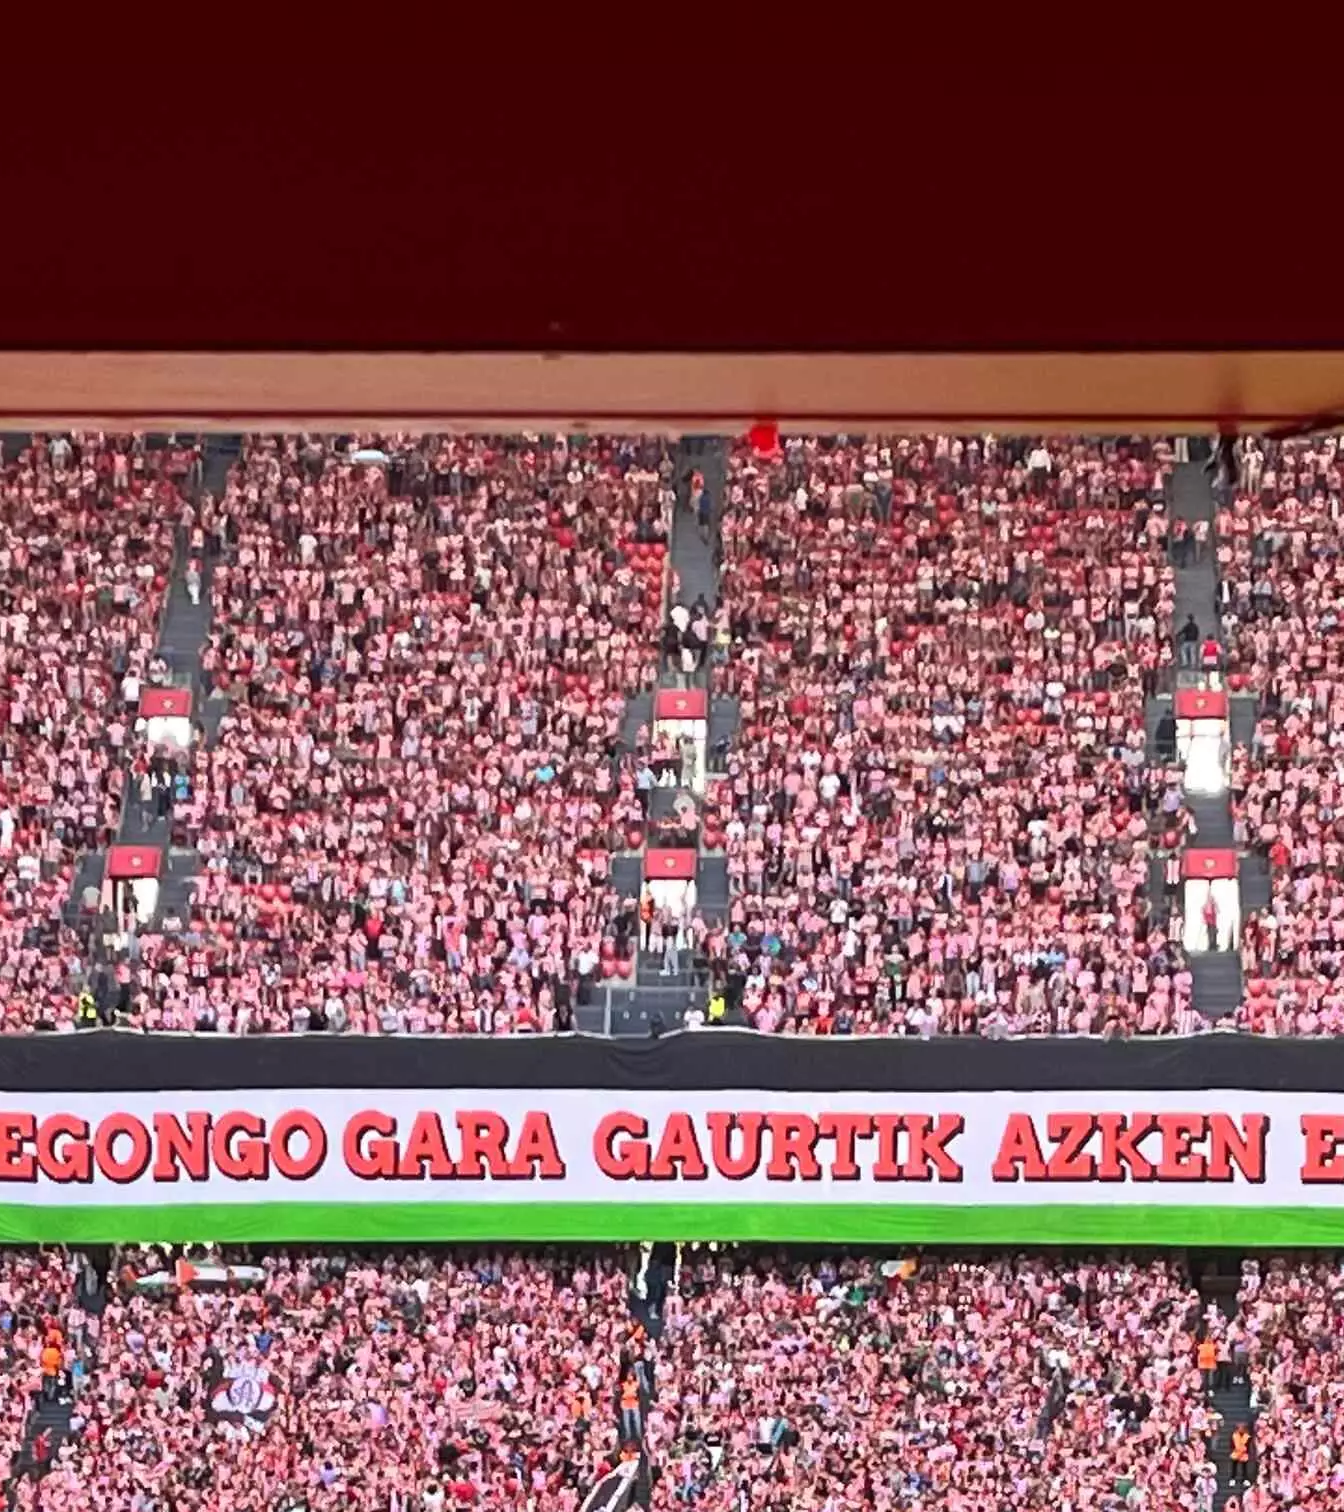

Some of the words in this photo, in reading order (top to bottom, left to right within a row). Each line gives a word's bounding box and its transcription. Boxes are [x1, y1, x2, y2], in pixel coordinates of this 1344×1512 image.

[343, 1109, 566, 1183] GARA
[592, 1109, 964, 1183] GAURTIK
[992, 1111, 1271, 1184] AZKEN
